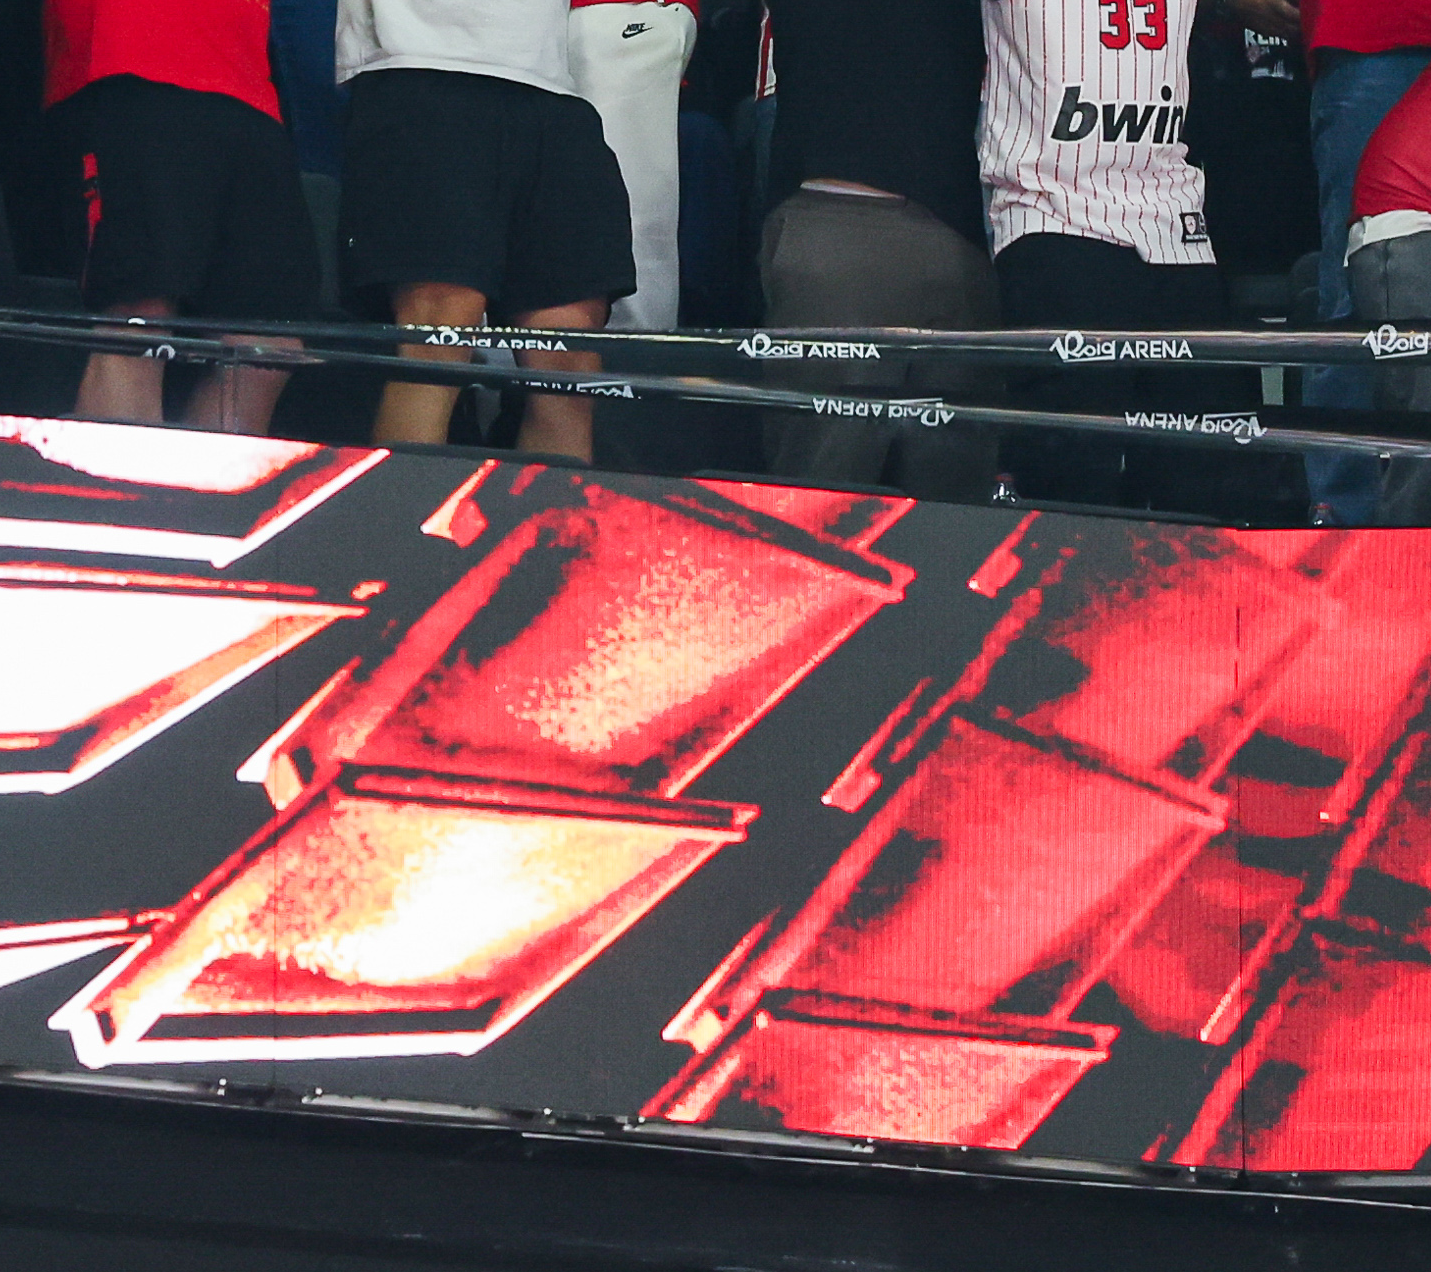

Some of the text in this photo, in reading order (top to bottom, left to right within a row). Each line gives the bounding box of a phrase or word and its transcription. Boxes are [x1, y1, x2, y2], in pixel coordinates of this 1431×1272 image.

[736, 332, 881, 360] Roig ARENA
[1048, 330, 1194, 363] Roig ARENA
[1361, 323, 1429, 360] Roig
[811, 397, 884, 416] ARENA
[1123, 410, 1198, 433] ARENA
